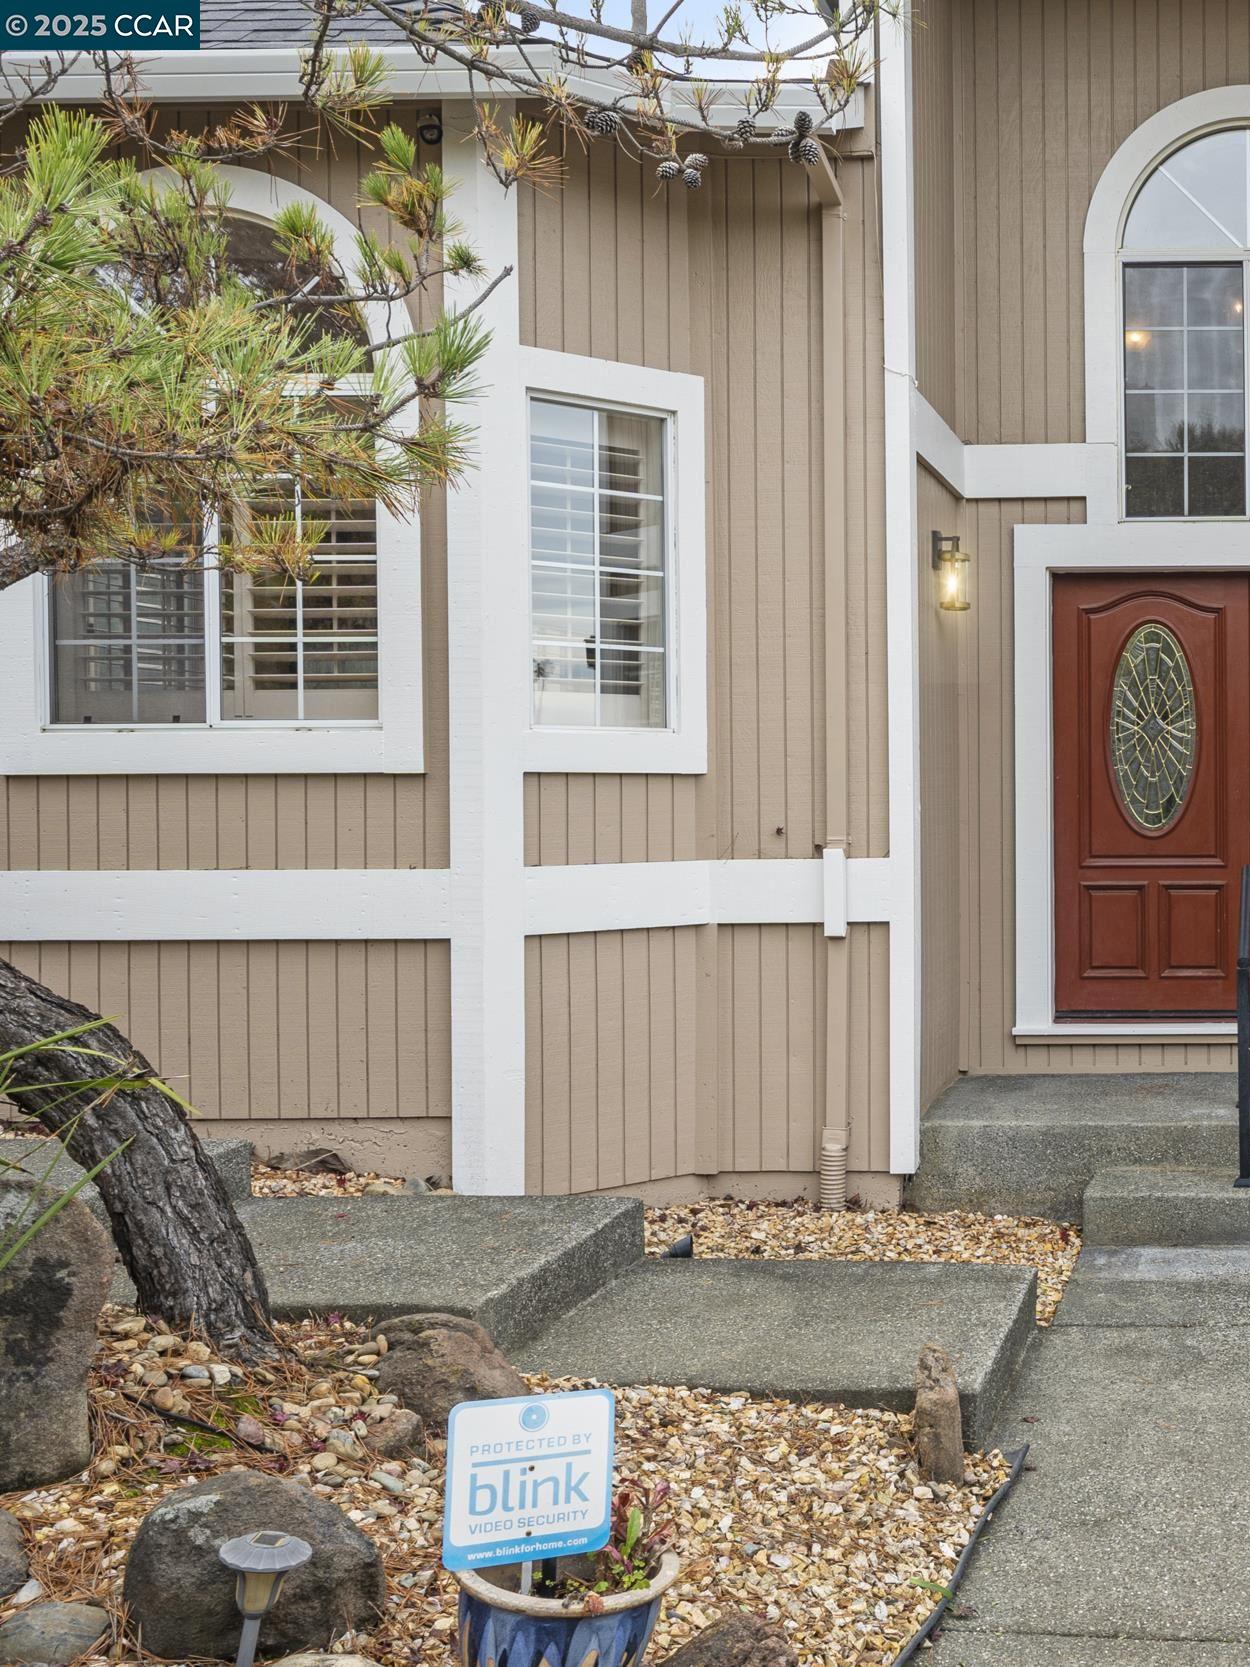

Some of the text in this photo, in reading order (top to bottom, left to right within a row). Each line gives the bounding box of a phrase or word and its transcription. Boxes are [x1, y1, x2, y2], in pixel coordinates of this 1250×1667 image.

[470, 1432, 592, 1457] PROTECTED BY
[468, 1461, 590, 1516] blink
[468, 1509, 589, 1535] VIDEO SECURITY
[467, 1536, 588, 1560] www.blinkforhome.com
